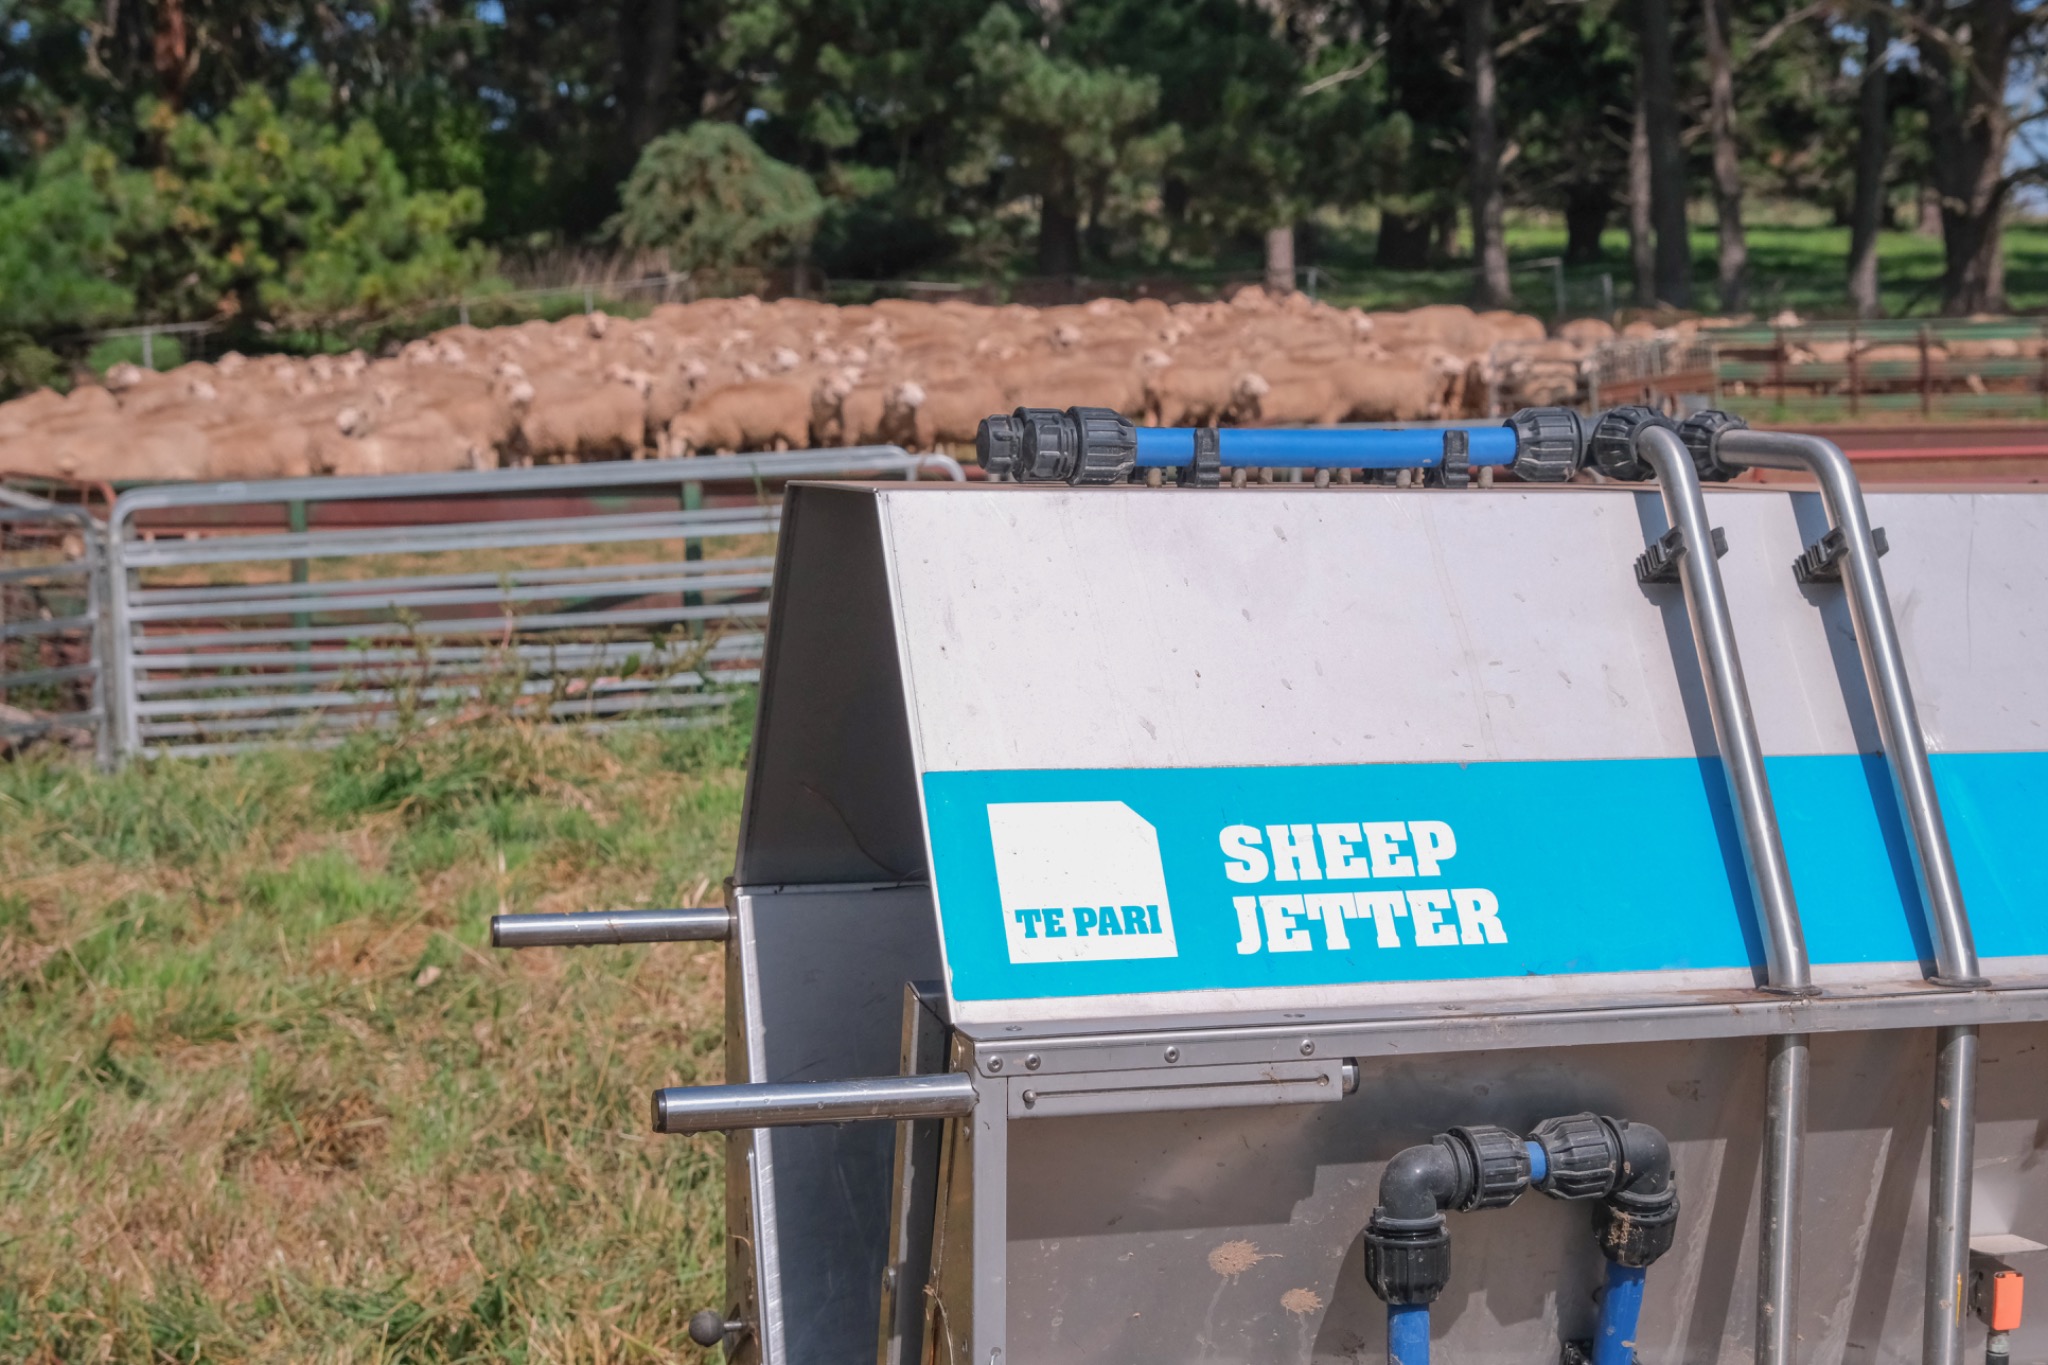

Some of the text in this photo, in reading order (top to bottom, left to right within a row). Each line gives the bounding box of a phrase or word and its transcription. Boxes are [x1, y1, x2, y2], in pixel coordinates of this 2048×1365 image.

[1220, 821, 1456, 883] SHEEP
[1015, 905, 1162, 938] TE PARI
[1233, 888, 1507, 954] JETTER
